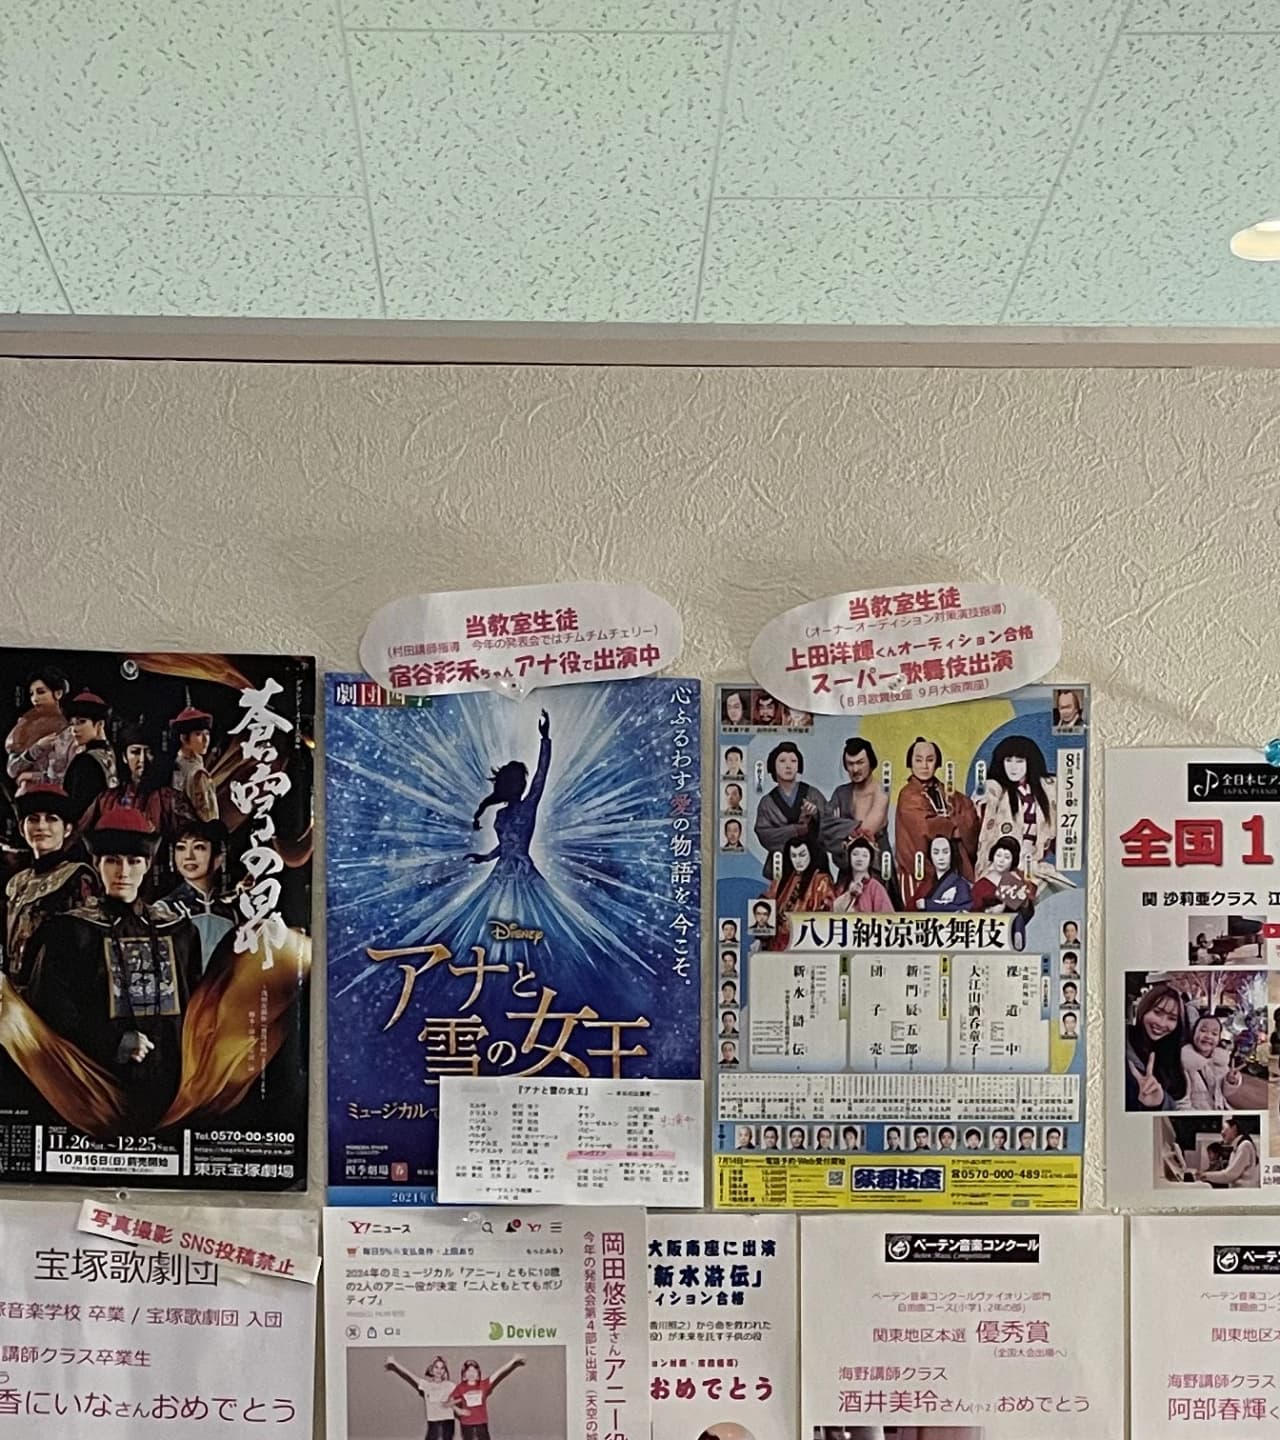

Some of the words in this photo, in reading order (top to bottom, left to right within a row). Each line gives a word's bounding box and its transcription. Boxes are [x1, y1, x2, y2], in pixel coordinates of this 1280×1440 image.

[849, 587, 961, 621] 当教室生徒
[466, 607, 579, 639] 当教室生徒
[811, 649, 1014, 694] スーパー歌舞伎出演
[669, 685, 692, 988] 心ふるわす愛の物語を、今こそ。
[794, 917, 1005, 950] 八月納涼歌舞伎
[366, 945, 540, 1031] アナと
[422, 988, 650, 1085] 雪の女王
[193, 1163, 295, 1179] 東京宝塚劇場
[90, 1208, 174, 1246] 写真撮影
[179, 1231, 296, 1277] SNS投稿禁止
[914, 1239, 1040, 1252] ベーテン音楽コンクール
[35, 1247, 219, 1287] 宝塚歌劇団
[90, 1304, 125, 1323] 卒業
[146, 1306, 239, 1328] 宝塚歌劇団
[246, 1309, 283, 1329] 入団
[872, 1328, 966, 1344] 関東地区本選
[975, 1320, 1050, 1344] 優秀賞
[650, 1376, 774, 1401] おめでとう
[838, 1366, 949, 1381] 海野講師クラス
[1167, 1374, 1276, 1389] 海野講師クラス
